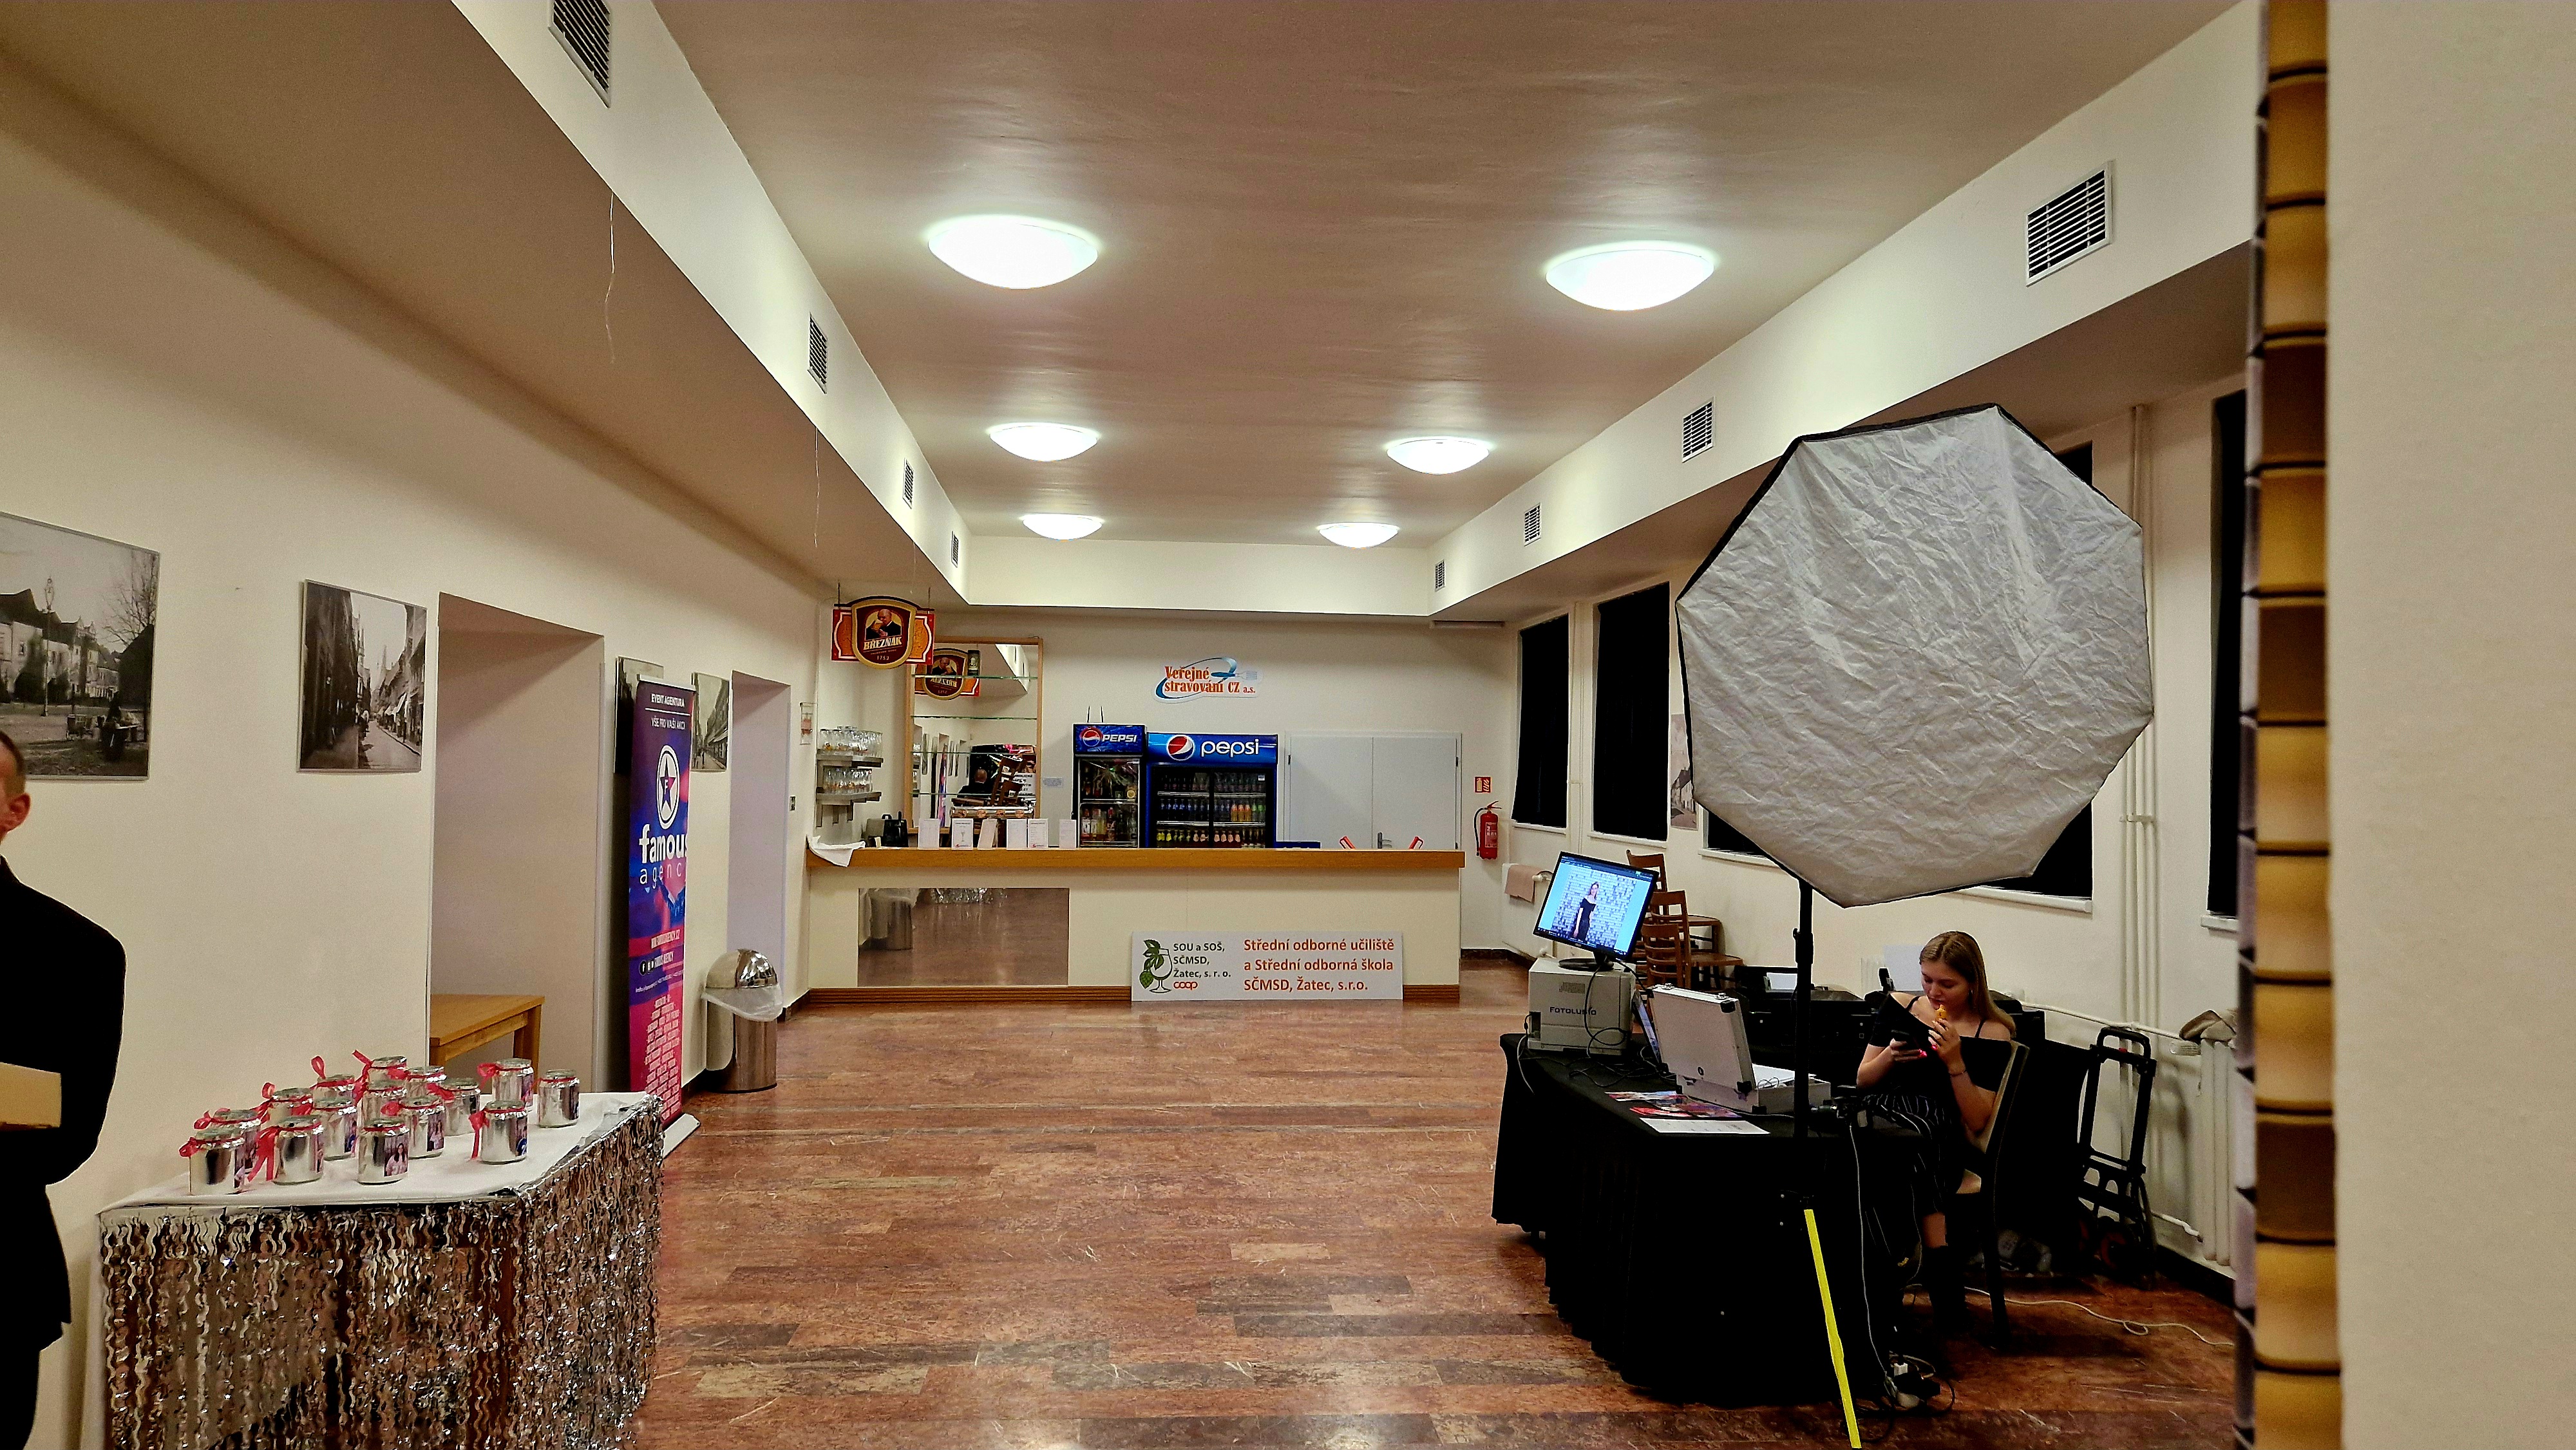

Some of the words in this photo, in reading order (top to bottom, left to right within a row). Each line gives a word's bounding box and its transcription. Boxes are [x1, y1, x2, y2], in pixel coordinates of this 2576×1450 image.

[1164, 666, 1209, 681] Veřejné
[1164, 680, 1224, 693] stravování
[1227, 682, 1240, 693] CZ
[1102, 734, 1137, 742] PEPSI
[1201, 739, 1259, 758] pepsi
[639, 862, 683, 889] agenc
[1204, 941, 1225, 952] SOŠ,
[1244, 939, 1289, 951] Střední
[1293, 939, 1347, 951] odborné
[1351, 938, 1394, 951] učiliště
[1173, 955, 1209, 965] SČMSD,
[1244, 961, 1251, 970] a
[1255, 958, 1301, 970] Střední
[1304, 958, 1358, 970] odborná
[1361, 958, 1394, 970] škola
[1173, 968, 1202, 978] Žatec,
[1173, 981, 1198, 990] coop
[1244, 976, 1293, 992] SČMSD,
[1296, 976, 1334, 992] Žatec,
[1338, 981, 1368, 991] s.r.o.
